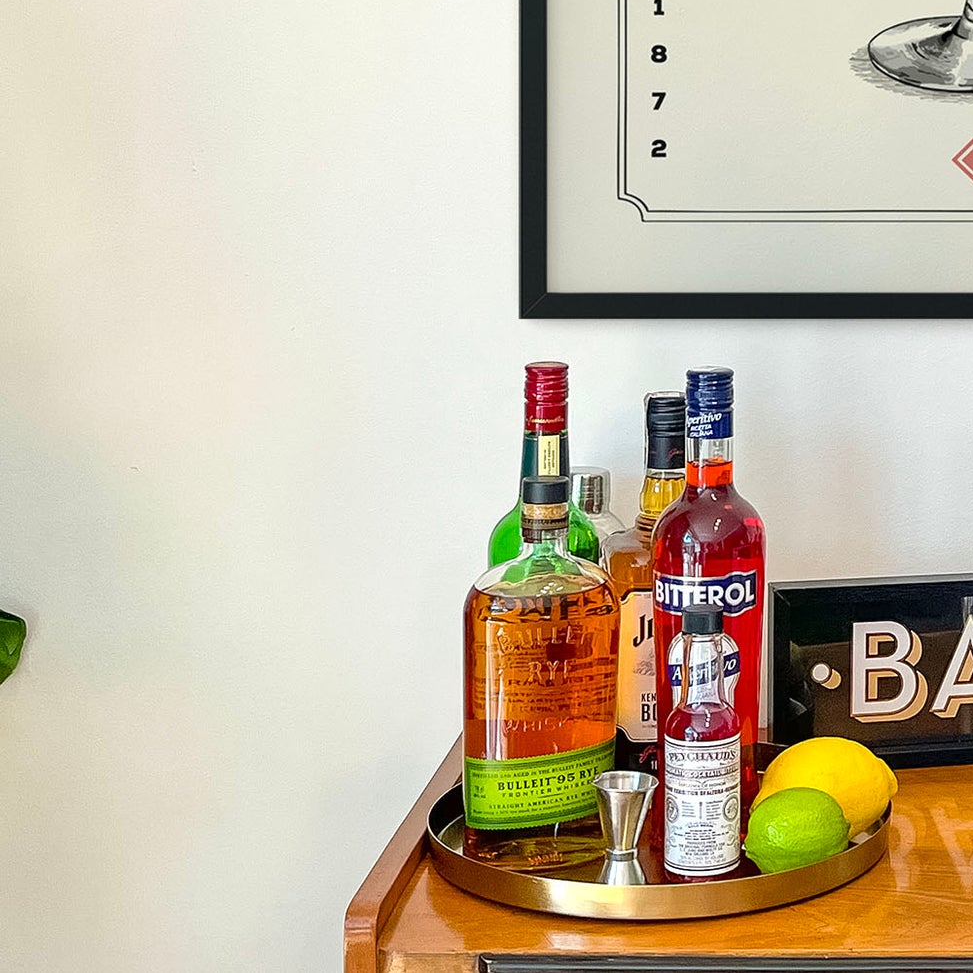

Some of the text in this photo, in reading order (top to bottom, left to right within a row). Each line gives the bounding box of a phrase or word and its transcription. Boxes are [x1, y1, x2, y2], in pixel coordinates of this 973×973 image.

[655, 580, 755, 606] BITTEROL
[557, 772, 576, 785] 95
[579, 765, 599, 780] RYE
[502, 787, 553, 798] FRONTIER
[527, 796, 564, 807] AMERICAN
